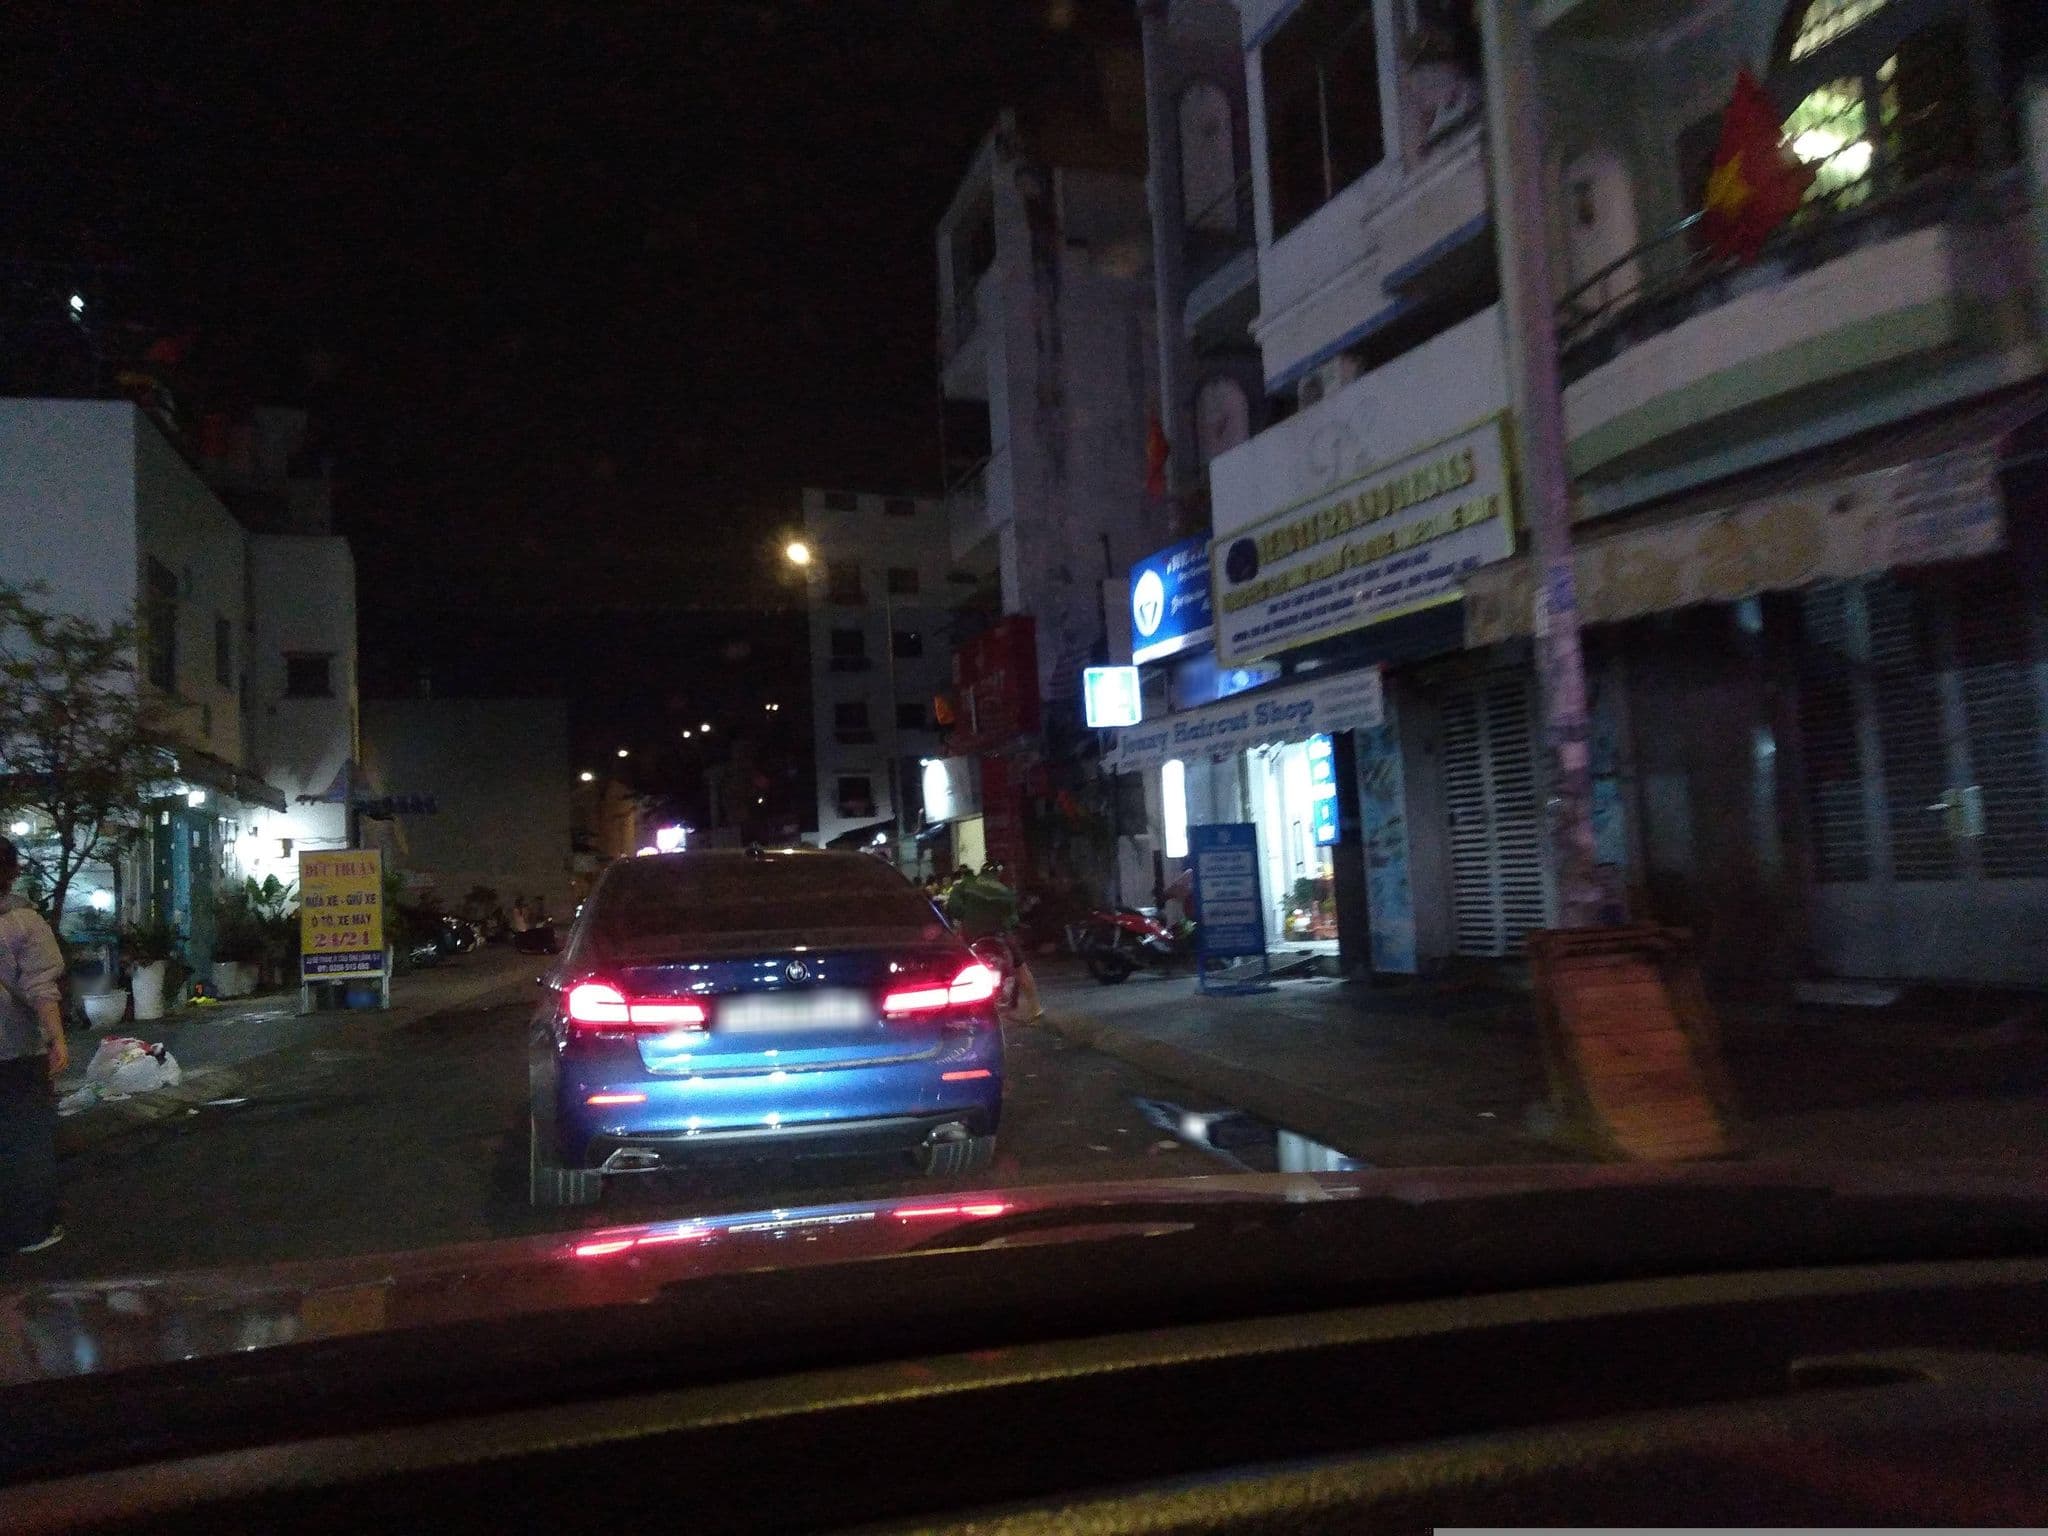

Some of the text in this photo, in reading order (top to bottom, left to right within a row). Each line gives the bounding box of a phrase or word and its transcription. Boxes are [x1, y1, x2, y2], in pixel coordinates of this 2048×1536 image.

[1254, 699, 1314, 726] Shop
[326, 894, 339, 906] XE
[364, 892, 377, 905] XE
[338, 914, 350, 926] XE
